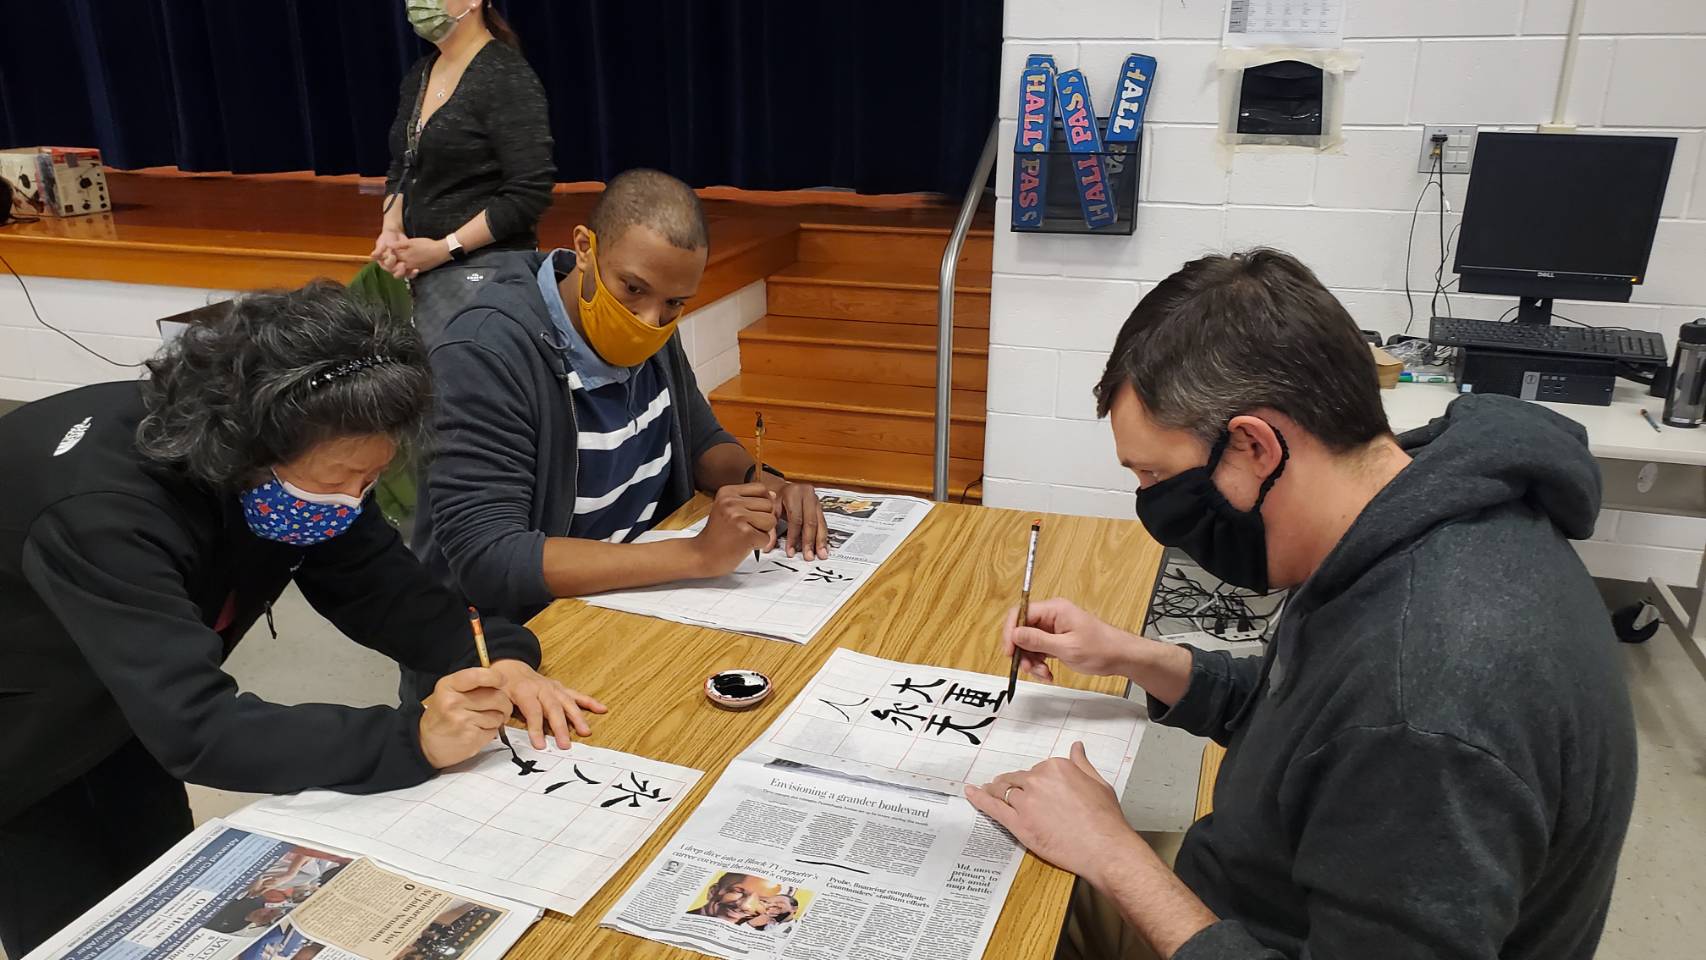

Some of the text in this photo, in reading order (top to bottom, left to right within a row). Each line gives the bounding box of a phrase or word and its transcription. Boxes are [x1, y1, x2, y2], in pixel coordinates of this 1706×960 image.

[1022, 73, 1047, 147] HALL
[1077, 150, 1110, 221] HALL
[769, 776, 828, 799] Envisioning
[828, 792, 836, 800] a
[836, 793, 878, 809] grander
[878, 800, 931, 819] boulevard
[208, 837, 240, 862] Advanced
[744, 856, 769, 868] Black
[768, 861, 780, 871] TV
[173, 861, 213, 892] Curriculum
[180, 855, 207, 874] Strong
[672, 850, 697, 861] career
[696, 855, 731, 871] covering
[730, 860, 745, 870] the
[774, 873, 806, 885] capital
[155, 873, 186, 895] Catholic
[852, 882, 888, 896] financing
[886, 887, 927, 902] complicate
[126, 896, 158, 917] Identity
[876, 893, 905, 904] stadium
[904, 897, 931, 909] efforts
[75, 920, 124, 955] Before/After
[94, 908, 156, 951] Student/Faculty
